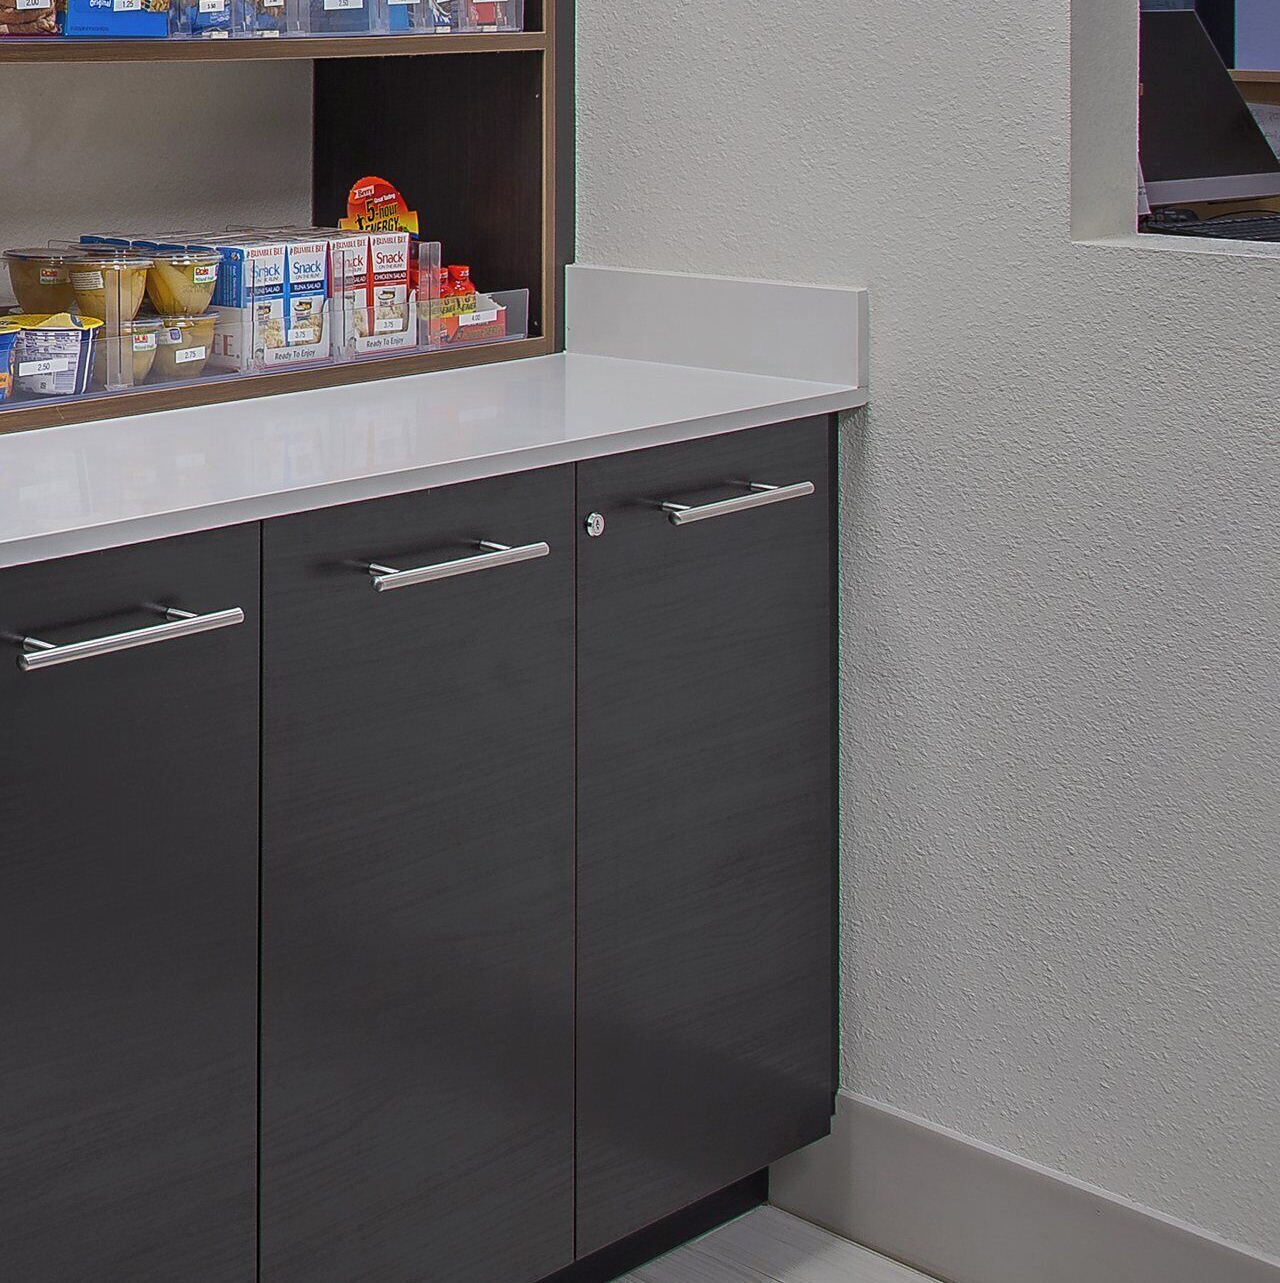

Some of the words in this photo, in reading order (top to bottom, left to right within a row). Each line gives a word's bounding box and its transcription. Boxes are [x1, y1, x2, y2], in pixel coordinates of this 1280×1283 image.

[122, 0, 134, 9] 1.25
[357, 188, 373, 198] Berry
[364, 198, 399, 223] 5-hour
[355, 239, 366, 247] BEE
[376, 237, 397, 245] BUMBLE
[397, 235, 407, 243] BEE
[250, 250, 273, 258] BUMBLE
[293, 247, 315, 255] BUMBLE
[375, 251, 404, 265] Snack
[195, 267, 210, 276] Dole
[253, 262, 280, 277] Snack
[293, 260, 322, 274] Snack
[293, 283, 307, 291] TUNA
[307, 281, 321, 289] SALAD
[471, 313, 481, 321] 4.00
[383, 320, 394, 329] 3.75
[295, 331, 306, 339] 3.75
[366, 339, 382, 348] Ready
[391, 337, 404, 346] Enjoy
[184, 351, 197, 359] 2.75
[274, 352, 291, 361] Ready
[301, 349, 315, 359] Enjoy
[37, 362, 51, 372] 2.50
